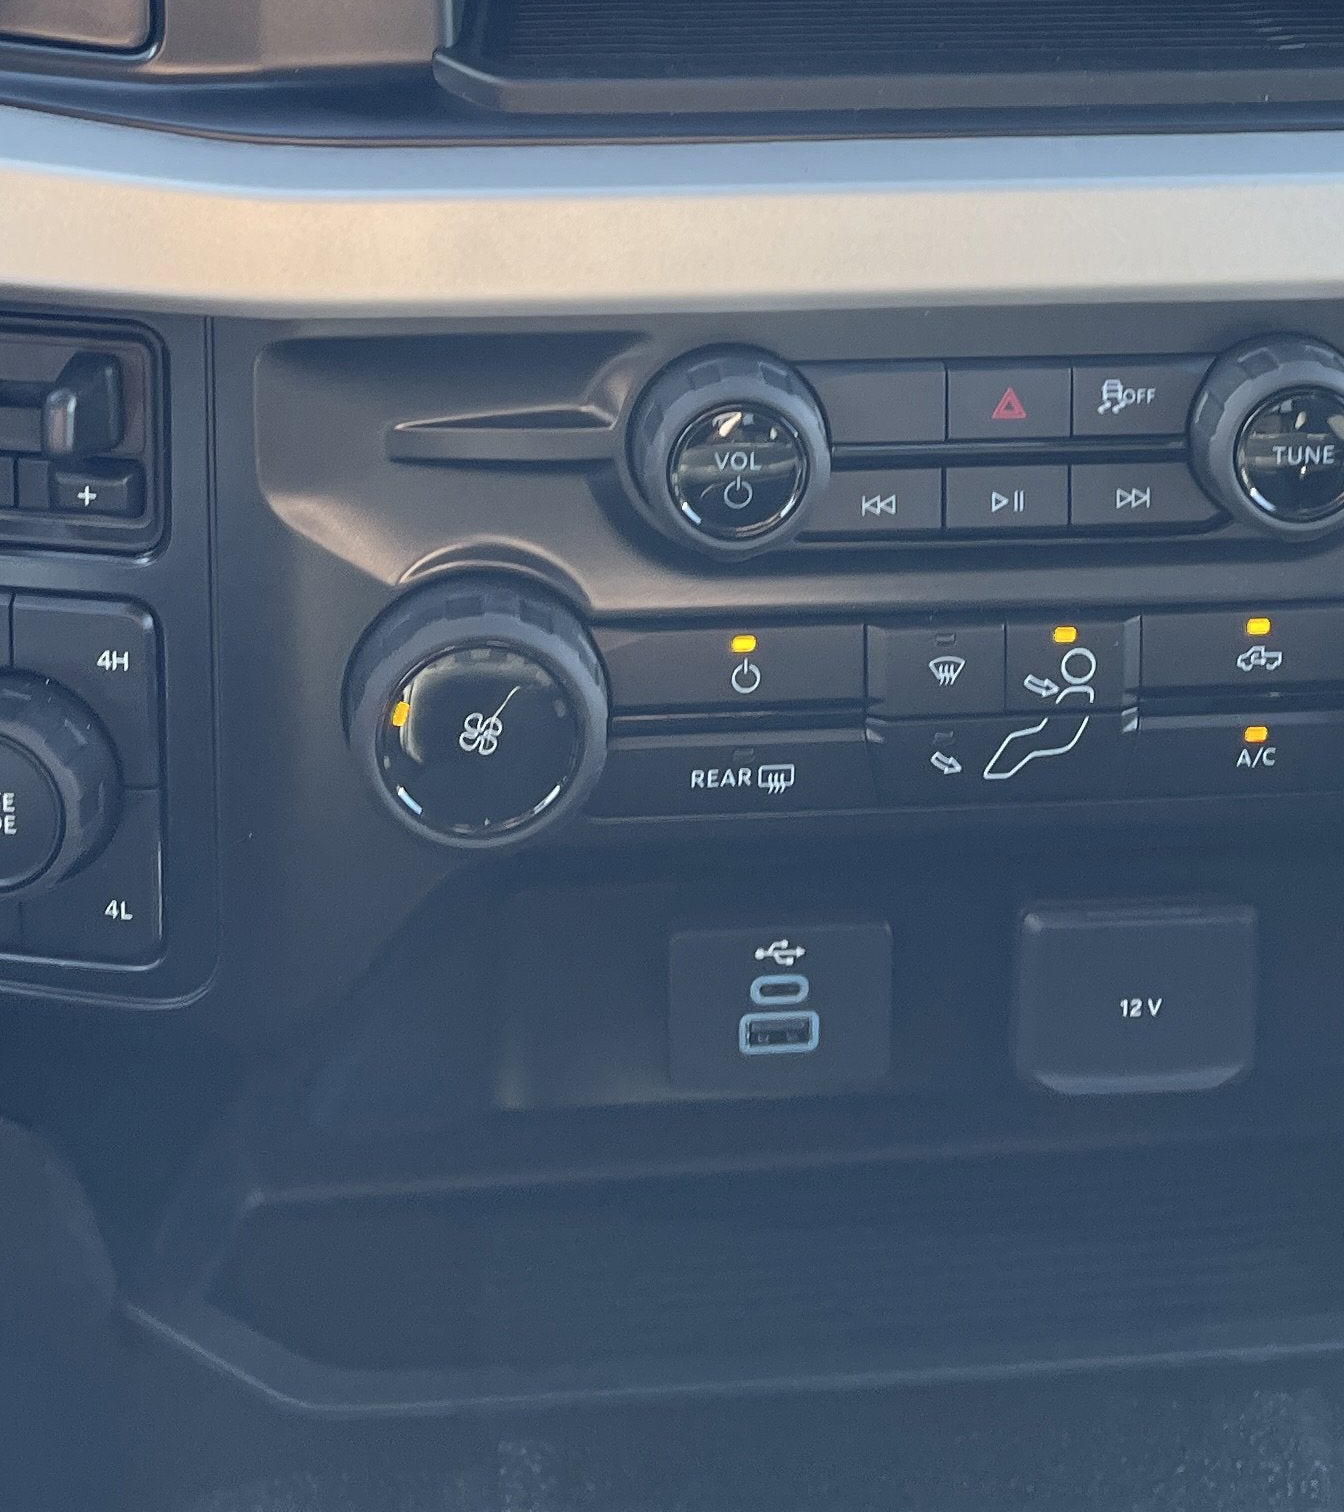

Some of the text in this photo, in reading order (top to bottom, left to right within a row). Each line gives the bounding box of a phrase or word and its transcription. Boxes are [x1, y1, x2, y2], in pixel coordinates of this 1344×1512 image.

[1123, 388, 1156, 405] OFF
[714, 451, 763, 472] VOL
[1272, 444, 1336, 466] TUNE
[96, 649, 130, 672] 4H
[1236, 747, 1277, 769] A/C
[690, 767, 753, 789] REAR
[104, 899, 134, 921] 4L
[1119, 997, 1163, 1018] 12 V
